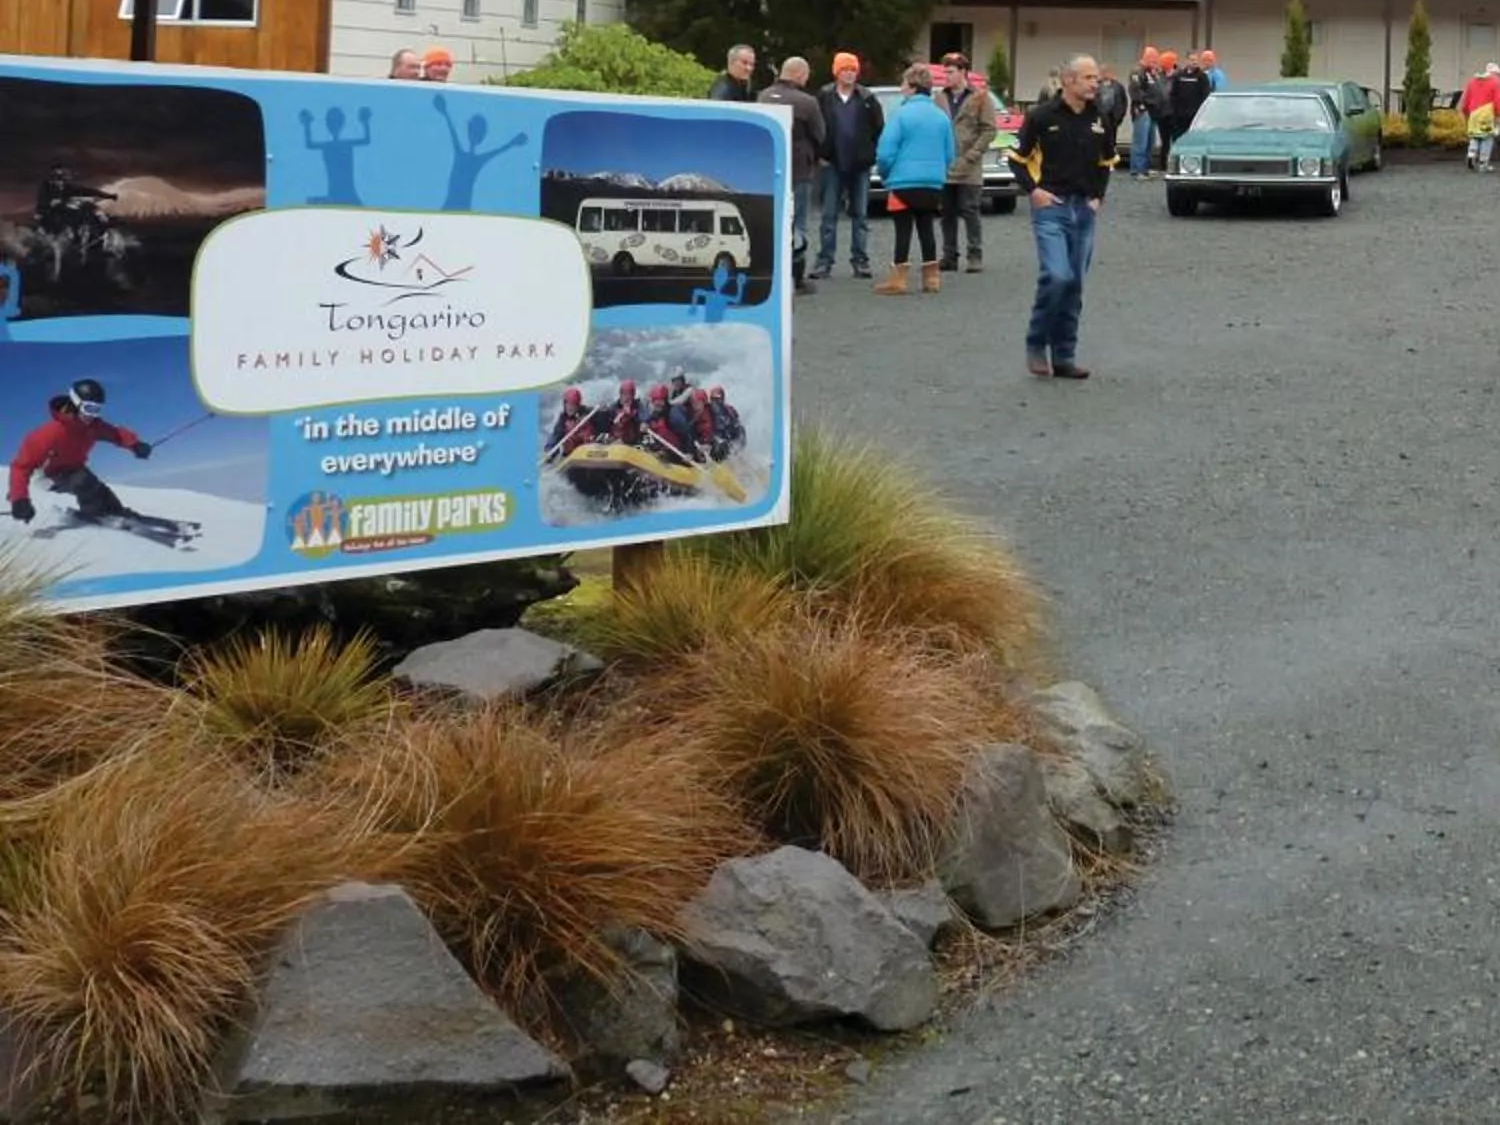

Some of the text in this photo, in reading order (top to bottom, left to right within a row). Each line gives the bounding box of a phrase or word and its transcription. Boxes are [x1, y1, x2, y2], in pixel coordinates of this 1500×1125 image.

[318, 302, 486, 340] Tongariro
[237, 341, 556, 369] FAMILY HOLIDAY PARK
[335, 412, 380, 437] the
[386, 407, 477, 434] middle
[482, 403, 511, 428] of
[350, 492, 507, 537] family parks
